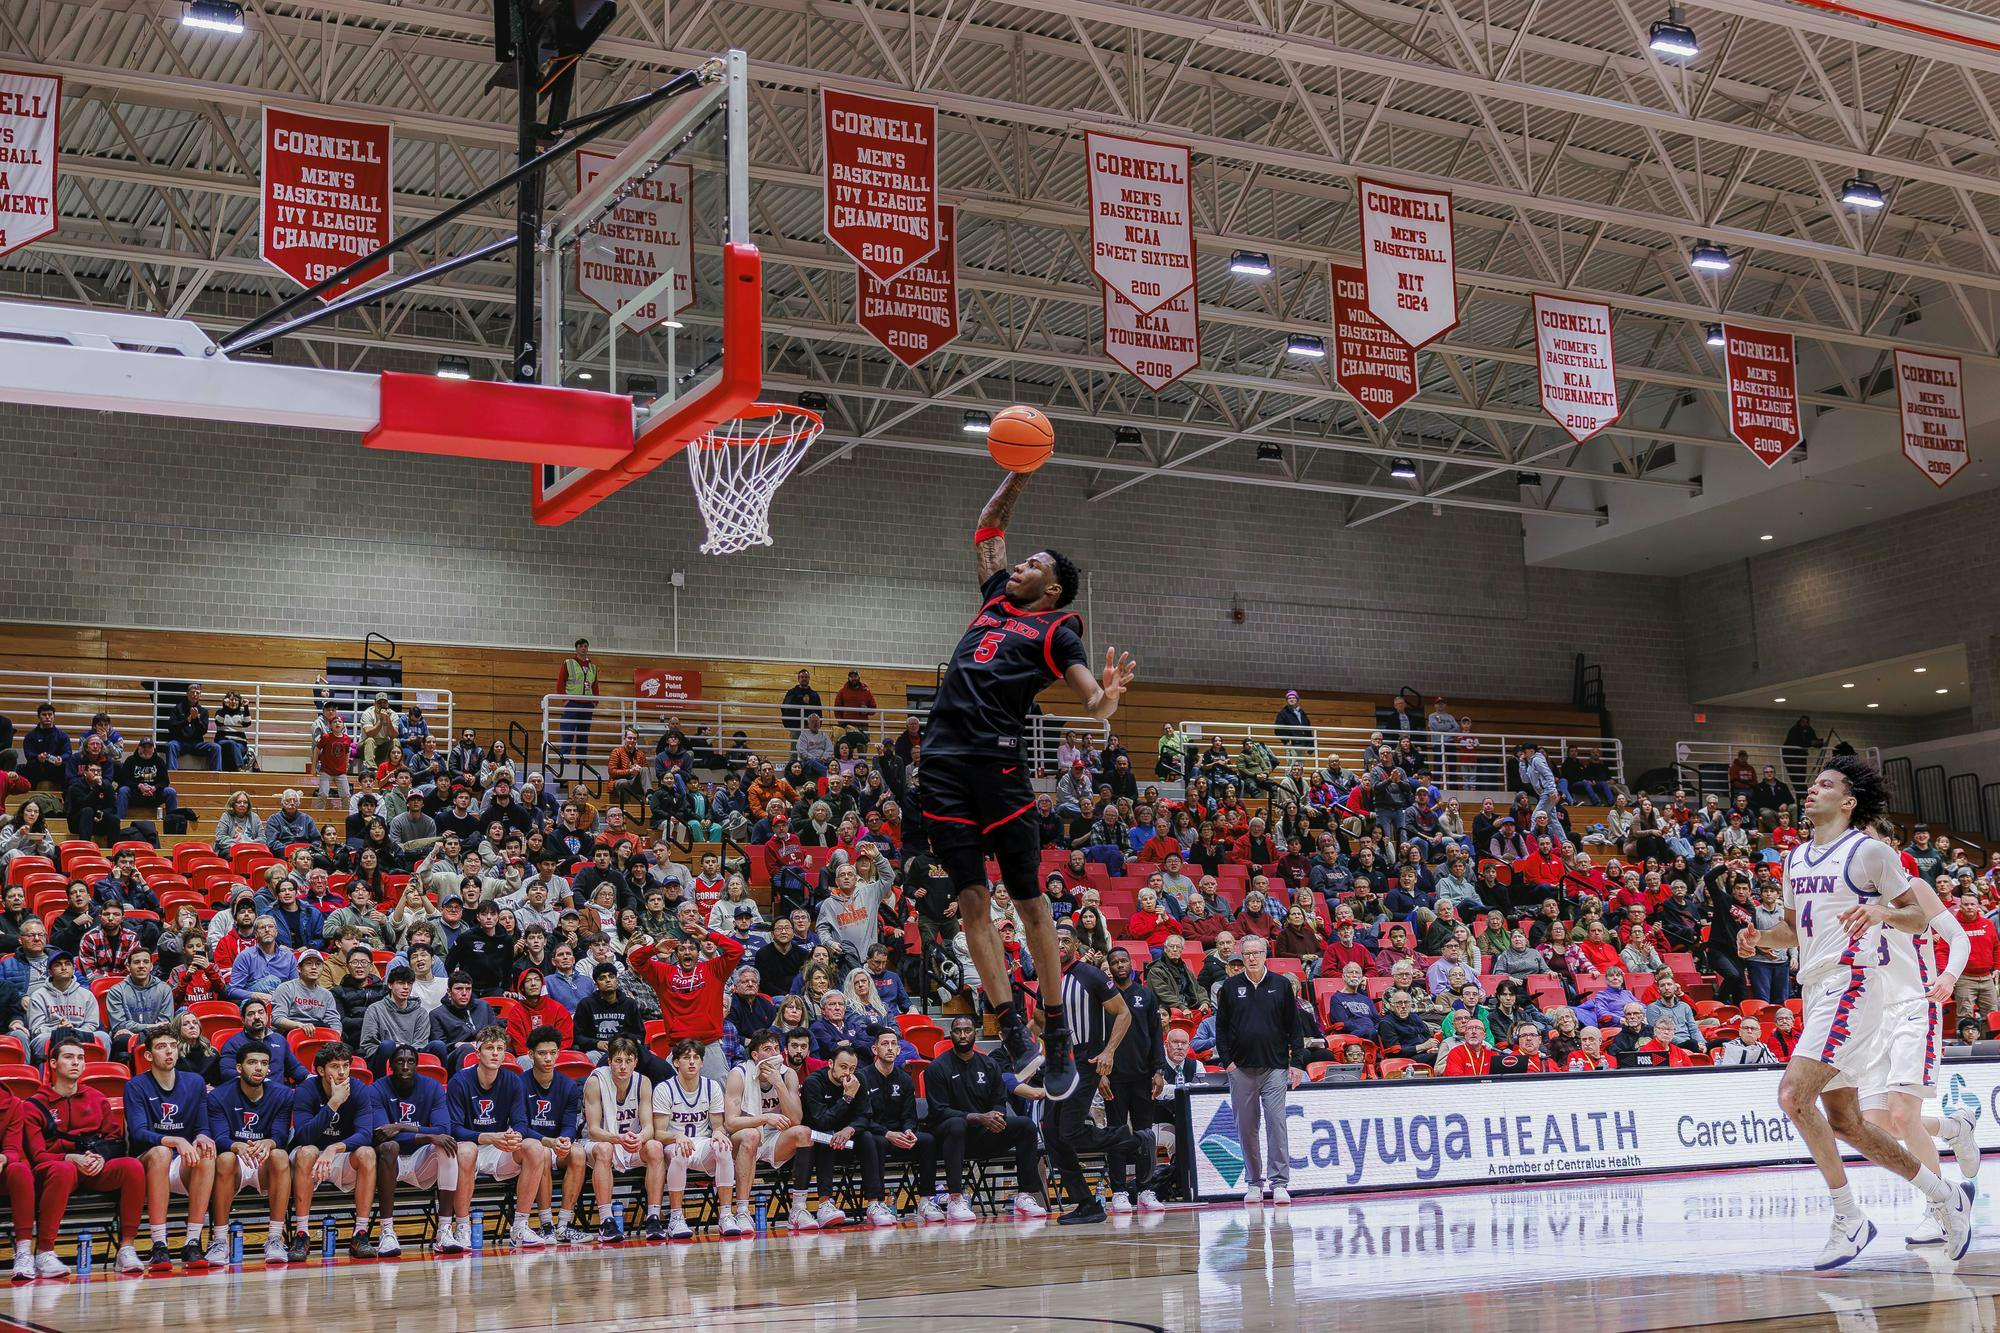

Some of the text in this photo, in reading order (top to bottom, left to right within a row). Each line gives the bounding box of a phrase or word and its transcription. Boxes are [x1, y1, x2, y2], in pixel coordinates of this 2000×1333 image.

[832, 109, 927, 145] CORNELL
[274, 129, 380, 164] CORNELL
[857, 148, 905, 169] MEN'S
[1096, 152, 1183, 184] CORNELL
[301, 167, 354, 189] MEN'S
[833, 163, 930, 192] BASKETBALL
[273, 183, 381, 213] BASKETBALL
[836, 185, 926, 212] IVY LEAGUE
[1121, 189, 1161, 207] MEN'S
[1368, 192, 1445, 222] CORNELL
[278, 206, 376, 233] IVY LEAGUE
[613, 208, 656, 226] MEN'S
[834, 205, 928, 240] CHAMPIONS
[1100, 202, 1182, 226] BASKETBALL
[273, 226, 380, 257] CHAMPIONS
[1125, 226, 1160, 246] NCAA
[1391, 226, 1426, 244] MEN'S
[614, 247, 656, 268] NCAA
[863, 243, 903, 264] 2010
[1096, 243, 1189, 268] SWEET SIXTEEN
[1374, 240, 1446, 263] BASKETBALL
[583, 262, 687, 290] TOURNAMT
[1398, 272, 1424, 292] NIT
[896, 283, 947, 303] LEAGUE
[1132, 280, 1160, 296] 2010
[1397, 293, 1428, 312] 2024
[865, 298, 950, 328] CHAMPIONS
[1541, 310, 1606, 335] CORNELL
[1135, 315, 1169, 332] NCAA
[888, 330, 928, 349] 2008
[1110, 328, 1194, 352] TOURNAMENT
[1339, 324, 1403, 344] BASKETBA
[1343, 342, 1408, 362] IVY LEAGUE
[1553, 338, 1596, 355] WOMEN'S
[1730, 339, 1789, 363] CORNELL
[1136, 361, 1172, 378] 2008
[1547, 352, 1607, 369] BASKETBALL
[1342, 358, 1411, 384] CHAMPIONS
[1563, 372, 1592, 388] NCAA
[1747, 366, 1776, 381] MEN'S
[1902, 364, 1957, 387] CORNELL
[1361, 387, 1393, 403] 2008
[1544, 385, 1614, 406] TOURNAMENT
[1733, 379, 1793, 399] BASKETBALL
[1919, 392, 1944, 404] MEN'S
[1737, 395, 1792, 414] IVY LEAGUE
[1907, 402, 1960, 419] BASKETBALL
[1567, 415, 1596, 429] 2008
[1738, 411, 1795, 434] CHAMPIONS
[1923, 422, 1947, 436] NCAA
[1754, 438, 1781, 452] 2009
[1906, 433, 1965, 452] TOURNAMENT
[1928, 461, 1951, 474] 2009
[1002, 618, 1039, 639] RED
[974, 631, 1006, 663] 5
[665, 674, 682, 682] Three
[666, 691, 688, 699] Lounge
[1791, 876, 1837, 895] PENN
[1801, 901, 1813, 937] 4
[154, 1122, 184, 1130] BASKETBALL
[672, 1111, 708, 1123] PENN
[1286, 1105, 1791, 1184] Cayuga HEALTH Care that
[1489, 1155, 1641, 1175] A member of Centralus Health
